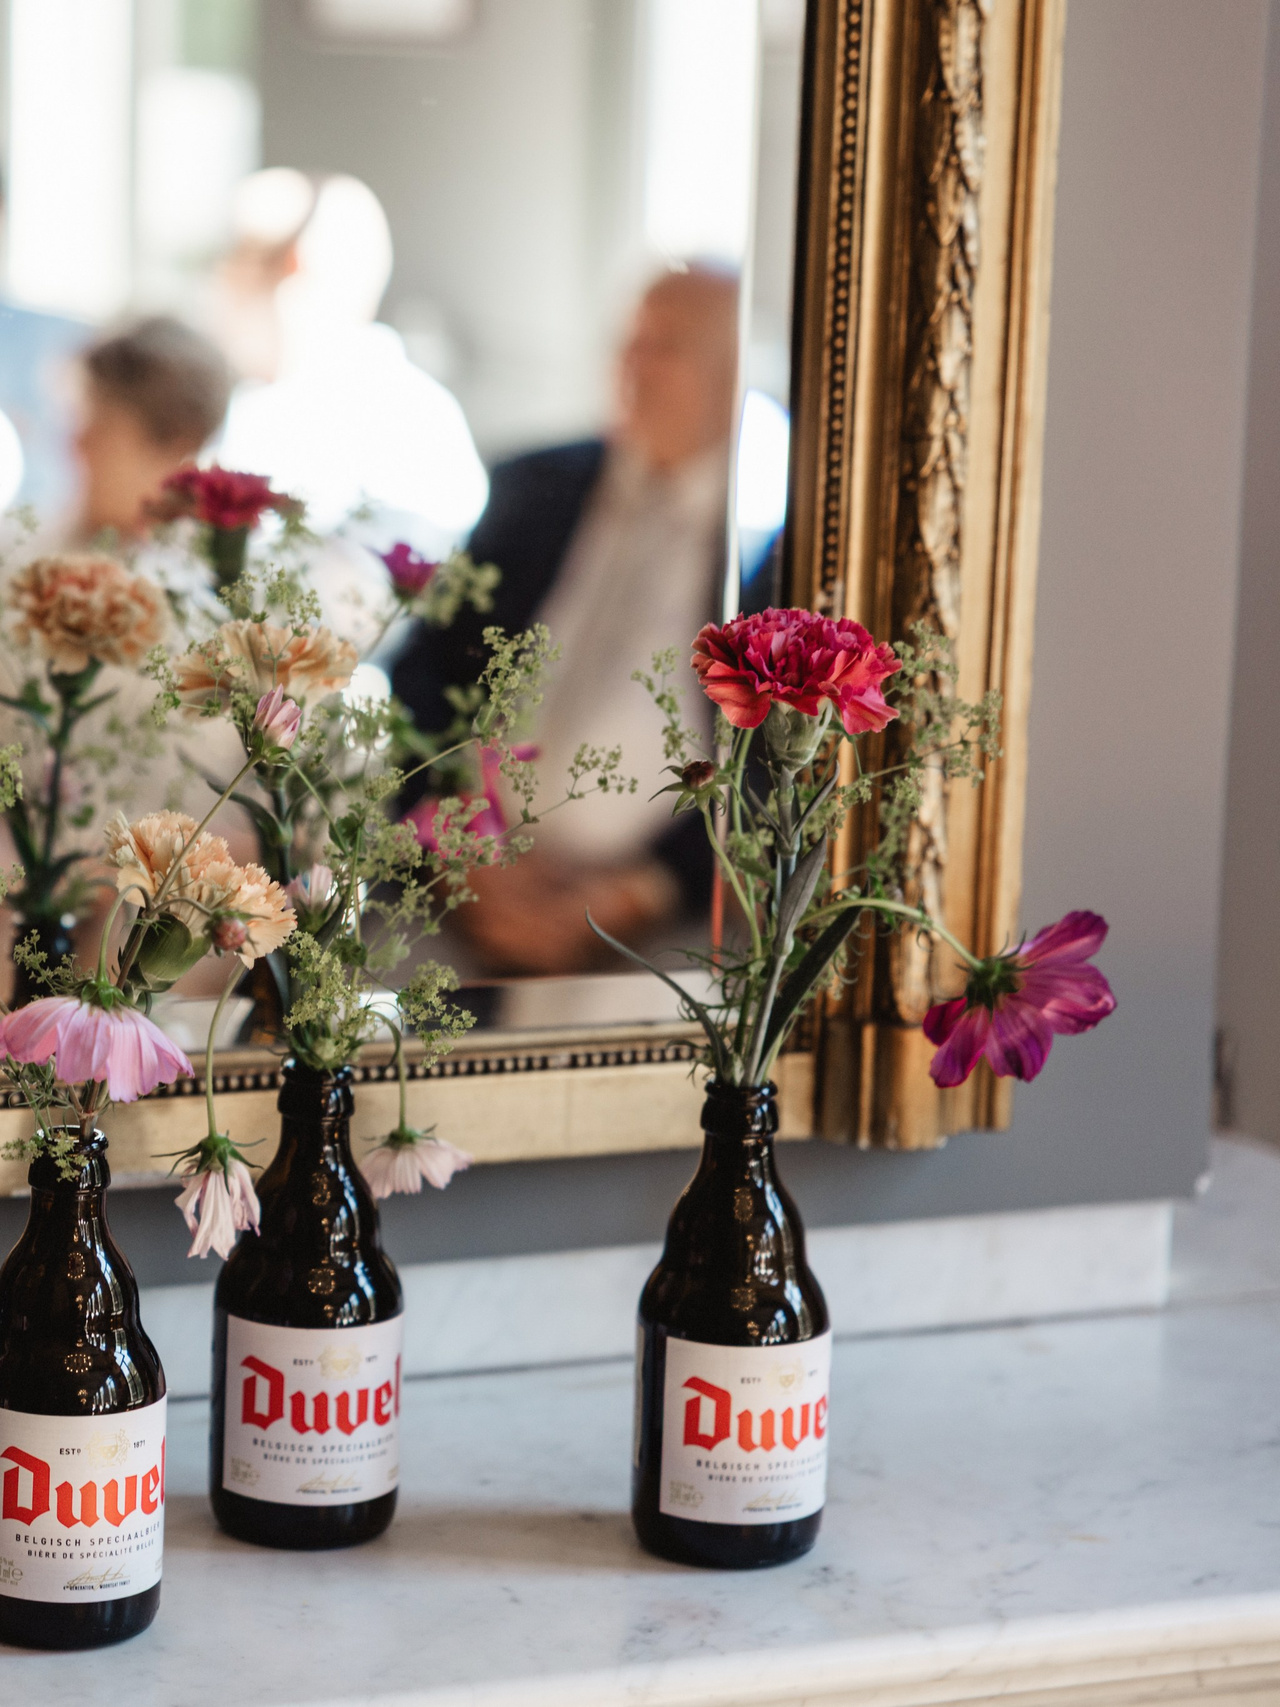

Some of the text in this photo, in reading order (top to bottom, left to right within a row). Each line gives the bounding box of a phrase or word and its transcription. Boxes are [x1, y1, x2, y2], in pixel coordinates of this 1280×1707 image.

[240, 1354, 401, 1436] Duvel
[682, 1376, 829, 1452] Duve
[133, 1440, 145, 1448] 1871
[253, 1438, 313, 1452] BELGISCH
[696, 1459, 760, 1470] BELGISCH
[16, 1521, 160, 1546] BELGISCH SPECIAALBIER
[27, 1549, 57, 1558] BIÈRE
[80, 1546, 132, 1559] SPÉCIALITÉ
[2, 1566, 11, 1579] ml
